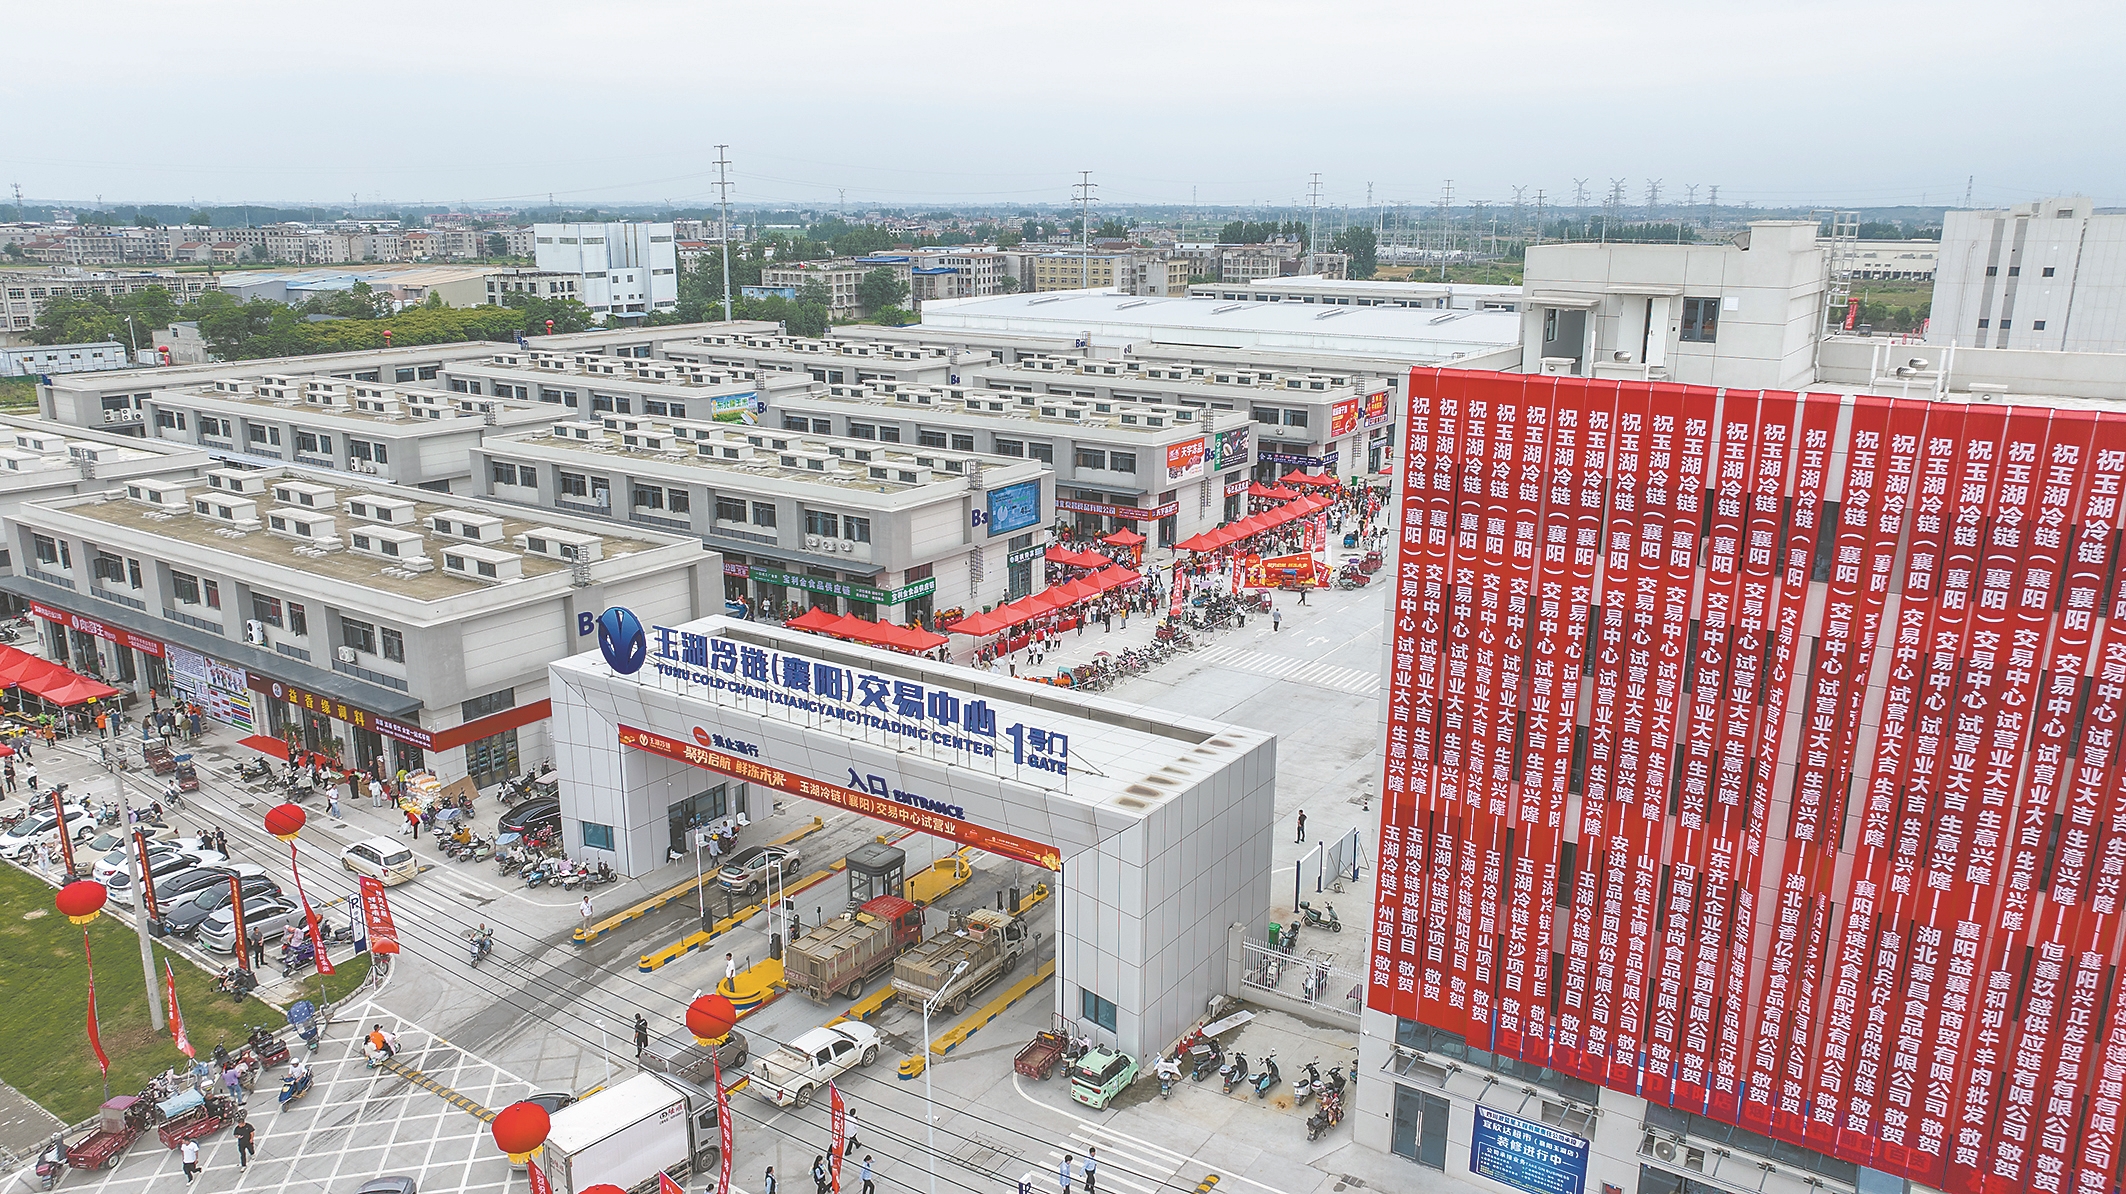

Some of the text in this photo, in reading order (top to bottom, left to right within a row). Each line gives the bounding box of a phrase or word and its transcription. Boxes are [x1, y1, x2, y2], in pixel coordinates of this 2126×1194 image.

[578, 611, 602, 637] B
[656, 663, 690, 681] YUHU
[692, 671, 726, 690] COLD
[931, 733, 995, 758] CENTER
[1027, 754, 1068, 776] GATE
[847, 767, 965, 820] 入口 ENTRANCE
[1373, 955, 1392, 988] 敬贺
[1397, 960, 1416, 993] 敬贺
[1423, 968, 1442, 1001] 敬贺
[1448, 976, 1466, 1010] 敬贺
[1471, 989, 1489, 1024] 敬贺
[1500, 997, 1521, 1032] 敬贺
[1558, 1013, 1580, 1049] 敬贺
[1586, 1025, 1608, 1058] 敬贺
[1615, 1034, 1636, 1067] 敬贺
[1649, 1043, 1671, 1078] 敬贺
[1682, 1053, 1705, 1086] 敬贺
[1749, 1071, 1773, 1106] 敬贺
[1780, 1079, 1802, 1116] 敬贺
[1813, 1091, 1838, 1127] 敬贺
[1846, 1097, 1872, 1135] 敬贺
[1881, 1108, 1908, 1146] 敬贺
[1917, 1118, 1945, 1156] 敬贺
[1496, 1135, 1562, 1166] 装修进行中
[1954, 1127, 1983, 1168] 敬贺
[1993, 1141, 2024, 1181] 敬贺
[2034, 1153, 2064, 1194] 敬贺
